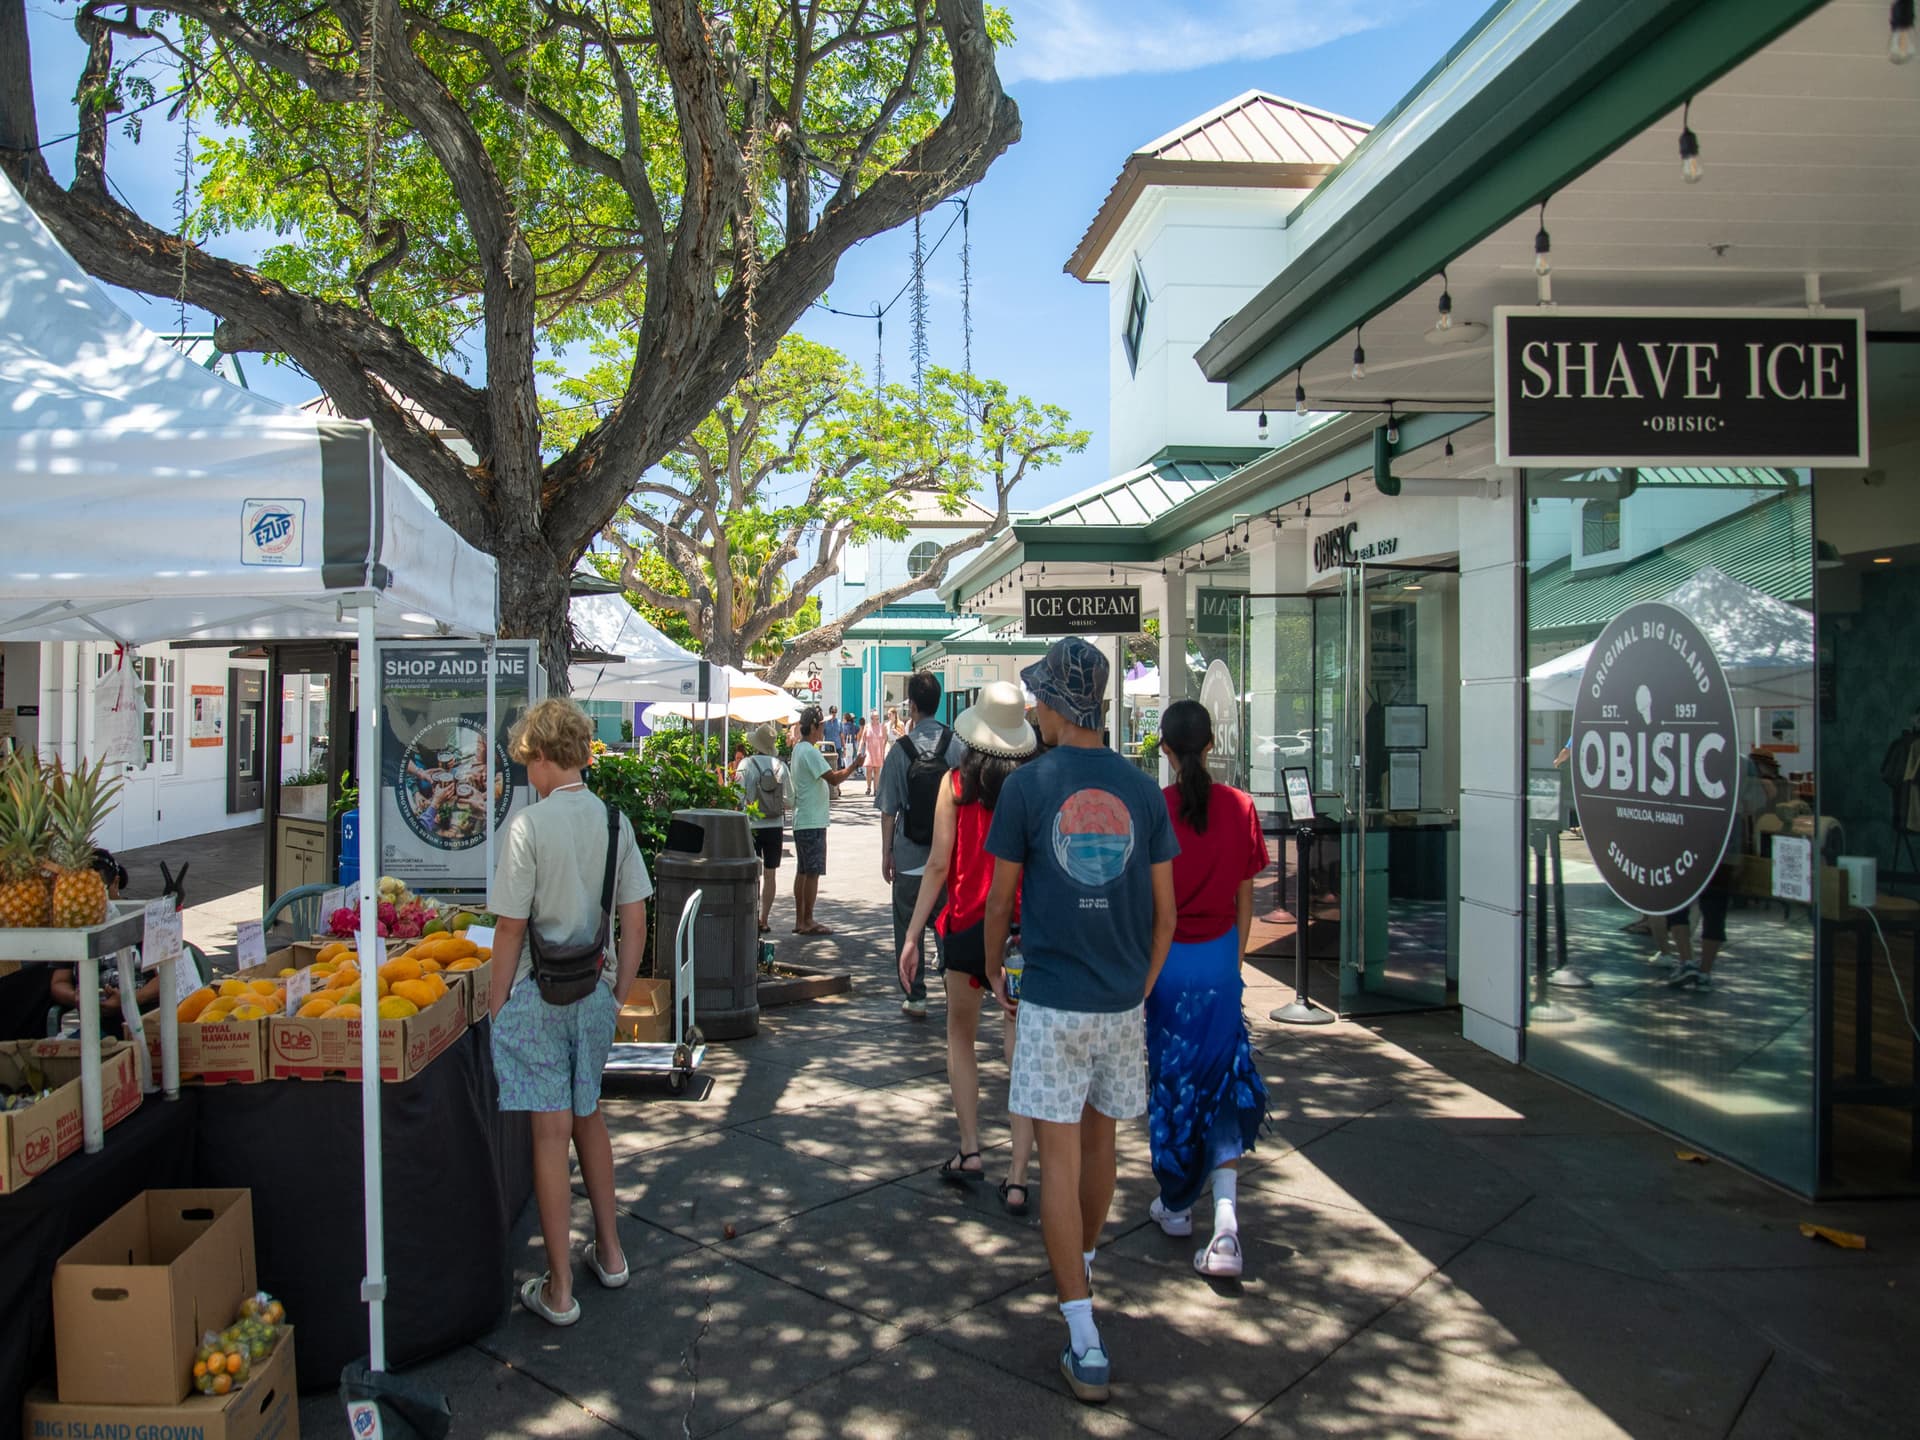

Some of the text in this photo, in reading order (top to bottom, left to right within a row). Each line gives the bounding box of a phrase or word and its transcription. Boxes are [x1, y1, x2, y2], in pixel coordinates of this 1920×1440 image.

[1521, 341, 1846, 400] SHAVE ICE
[1650, 416, 1717, 431] OBISIC
[1314, 521, 1358, 573] OBISIC
[1377, 537, 1398, 556] 1957
[1029, 595, 1136, 617] ICE CREAM
[385, 660, 435, 675] SHOP
[439, 660, 477, 675] AND
[1591, 621, 1711, 699] ORIGINAL BIG ISLAND
[1602, 705, 1620, 718] EST.
[1675, 704, 1697, 718] 1957
[473, 721, 488, 734] BELO
[1579, 730, 1727, 800] OBISIC
[1607, 841, 1699, 887] SHAVE ICE CO.
[201, 1024, 231, 1034] ROYAL
[201, 1032, 250, 1042] HAWAIIAN
[280, 1031, 312, 1048] Dole
[25, 1134, 50, 1161] Dole
[34, 1420, 204, 1440] BIG ISLAND GROWN
